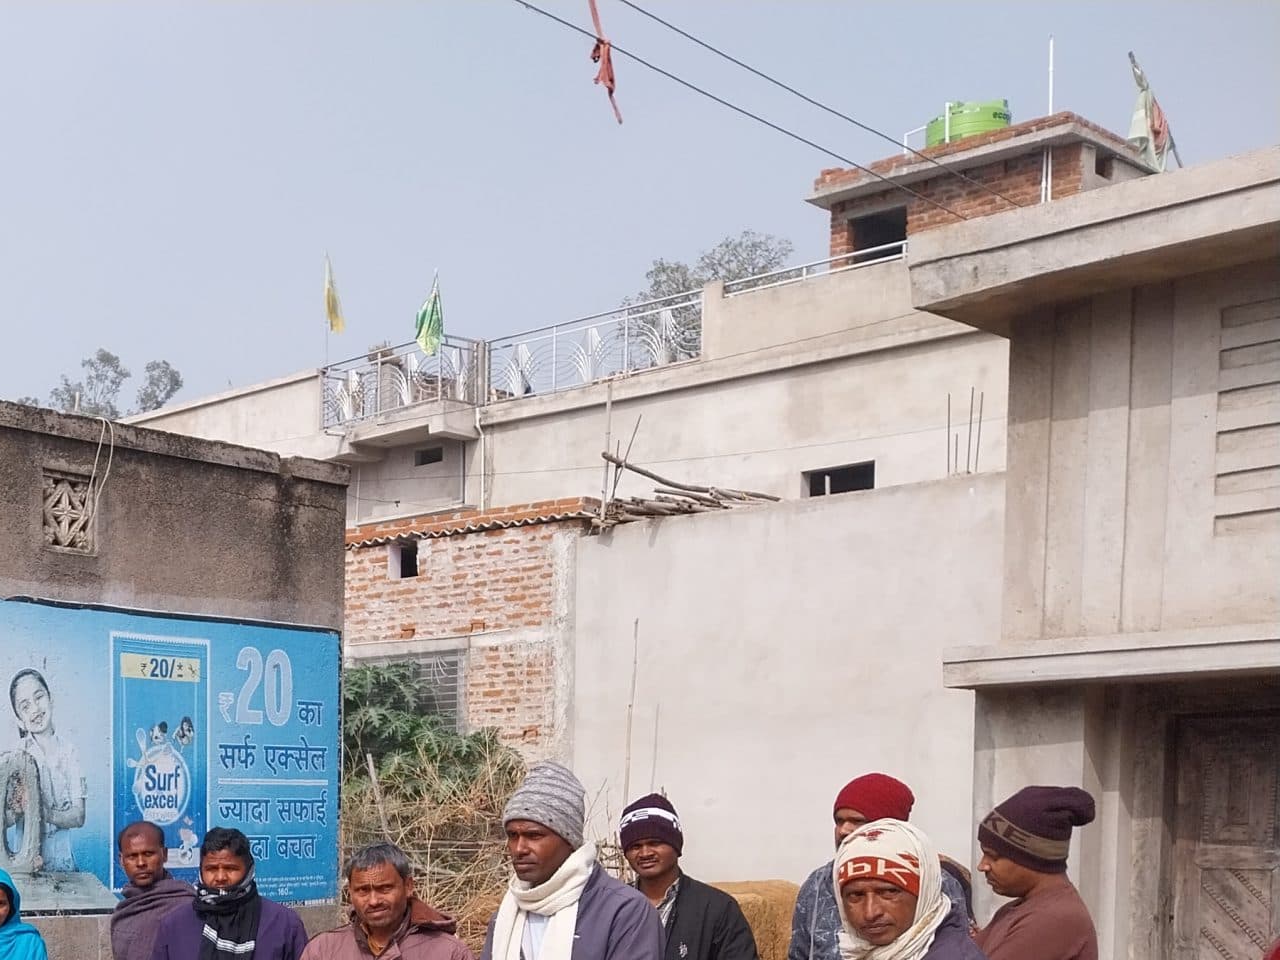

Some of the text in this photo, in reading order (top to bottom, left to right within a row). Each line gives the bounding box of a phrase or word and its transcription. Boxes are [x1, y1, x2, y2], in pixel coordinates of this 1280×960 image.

[297, 699, 324, 727] का
[219, 733, 328, 777] सर्फ एक्सेल
[144, 764, 181, 792] Surf
[144, 793, 178, 809] excel
[218, 788, 328, 828] ज्यादा सफाई
